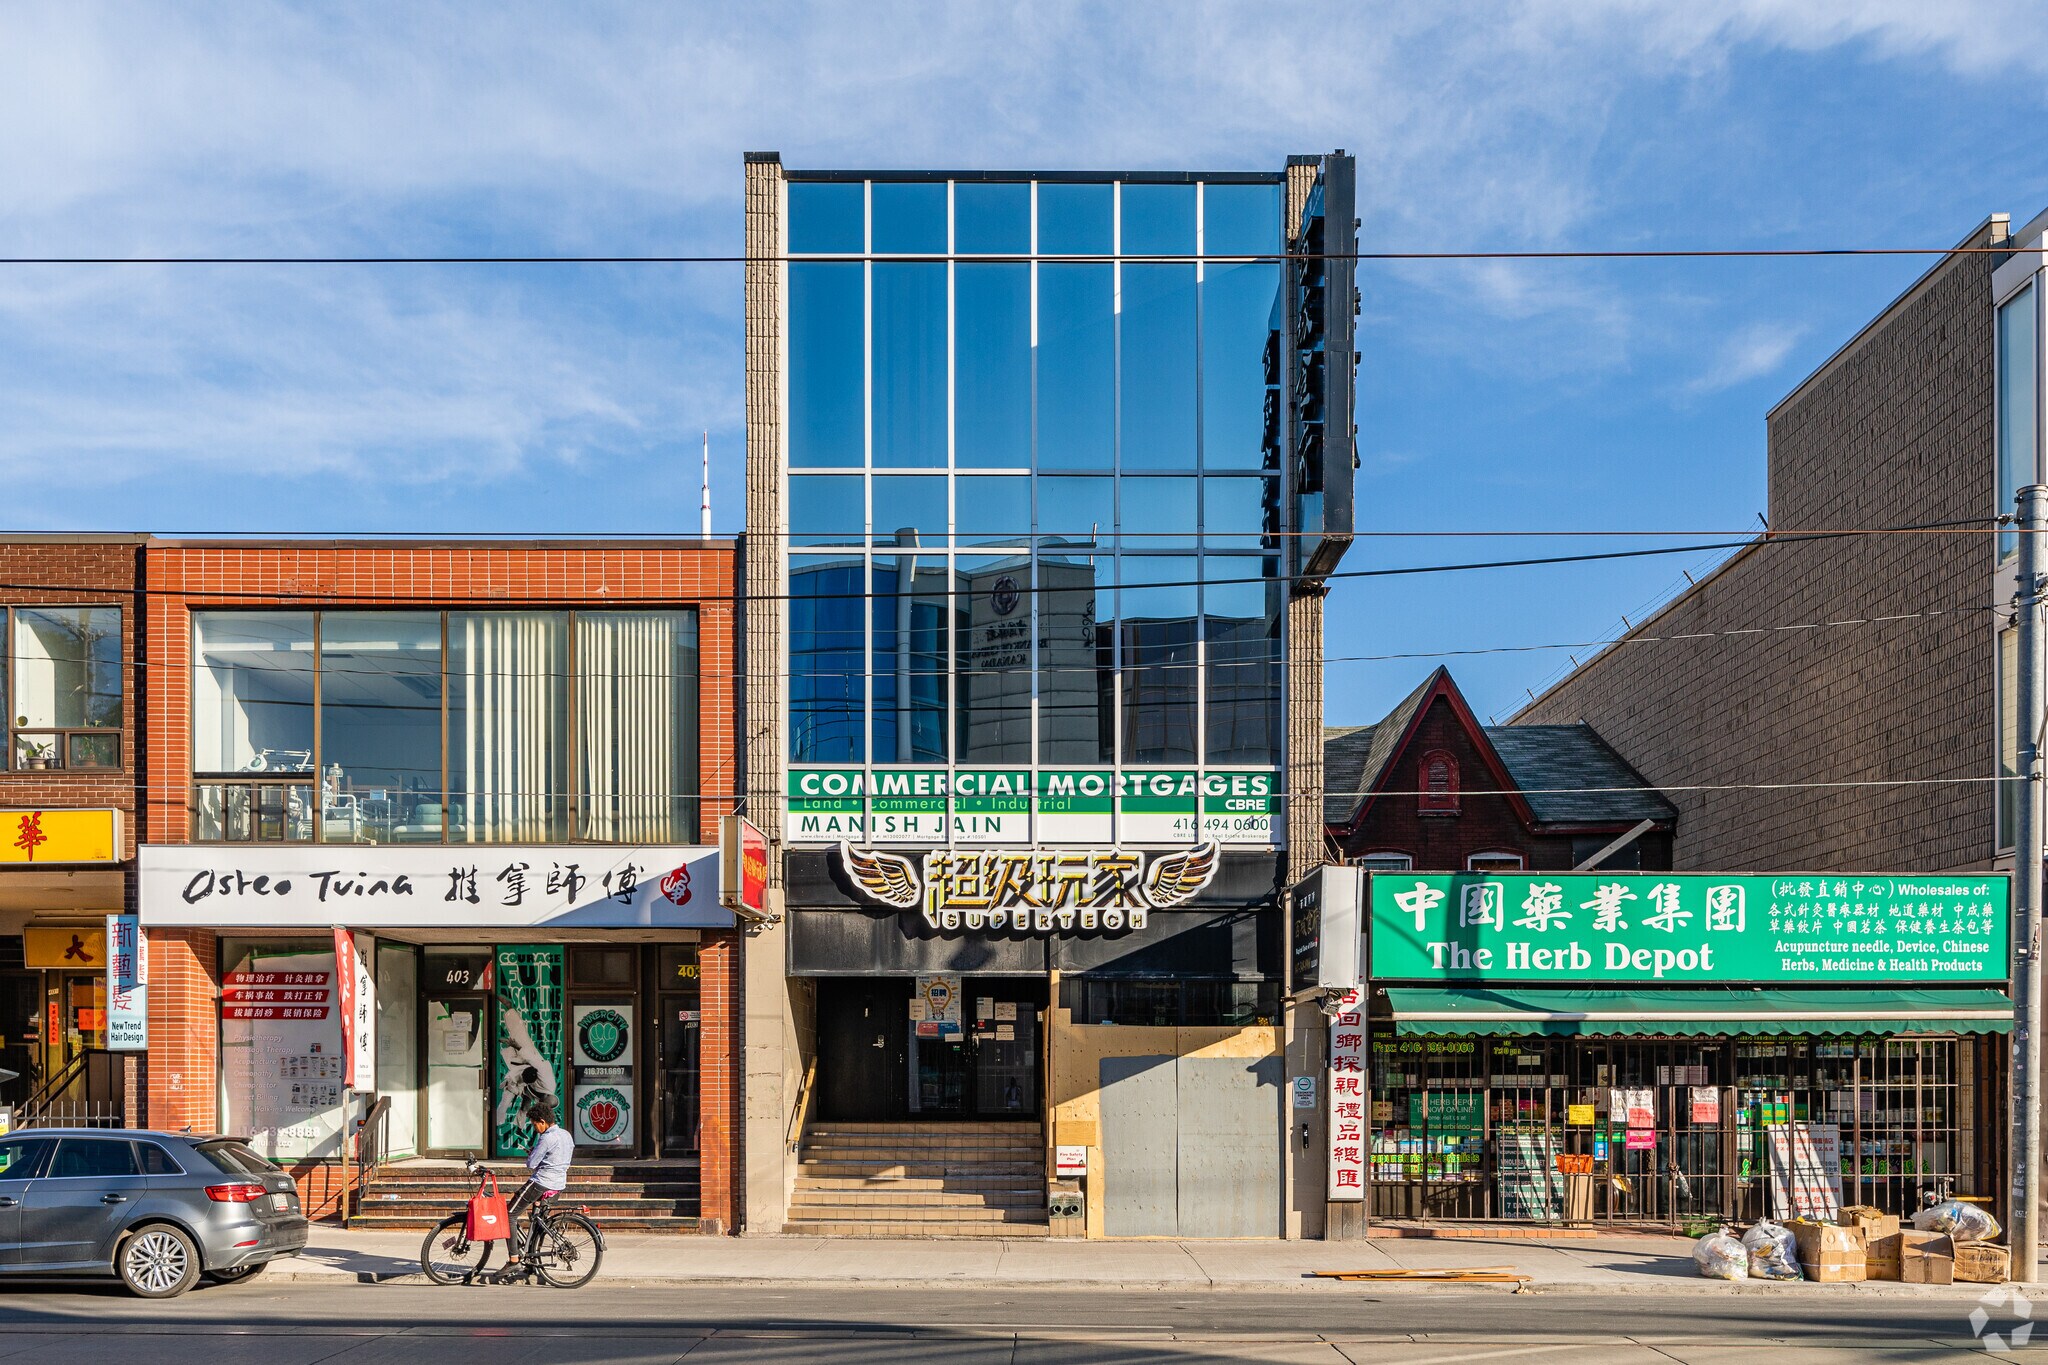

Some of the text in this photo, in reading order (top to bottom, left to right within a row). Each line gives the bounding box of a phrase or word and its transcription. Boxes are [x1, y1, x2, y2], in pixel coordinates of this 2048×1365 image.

[800, 773, 1269, 796] COMMERCIAL MORTGAGES
[803, 797, 842, 809] Land
[992, 797, 1071, 811] Indutrial
[1225, 799, 1266, 811] CBRE
[801, 816, 1001, 833] MANISH JAIN
[1173, 817, 1269, 831] 416 494 0600
[14, 811, 47, 861] 華
[181, 870, 292, 904] Osteo
[309, 869, 414, 903] Tuina
[927, 852, 1145, 915] 超级玩家
[1898, 883, 1970, 896] Wholesales
[1973, 883, 1990, 896] of:
[1393, 881, 1746, 932] 中國藥業集團
[945, 912, 1143, 928] SUPERTECH
[64, 934, 94, 963] 大
[1775, 940, 1990, 955] Acupuncture needle, Device, Chinese
[499, 952, 562, 963] COURAGE
[1426, 941, 1715, 978] The Herb Depot
[1781, 958, 1983, 973] Herbs, Medicine & Health Products
[235, 974, 275, 983] 物理治疗
[446, 970, 470, 984] 403
[500, 964, 561, 987] FUN
[111, 1021, 142, 1030] New Trend
[110, 1032, 144, 1043] Hair Design
[233, 1034, 283, 1042] Physiotherapy
[266, 1046, 295, 1055] Therapy
[233, 1058, 277, 1067] Acupuncture
[233, 1070, 273, 1079] Osteopathy
[233, 1082, 277, 1091] Chiropractor
[256, 1094, 279, 1102] Billing
[285, 1105, 316, 1113] Welcome
